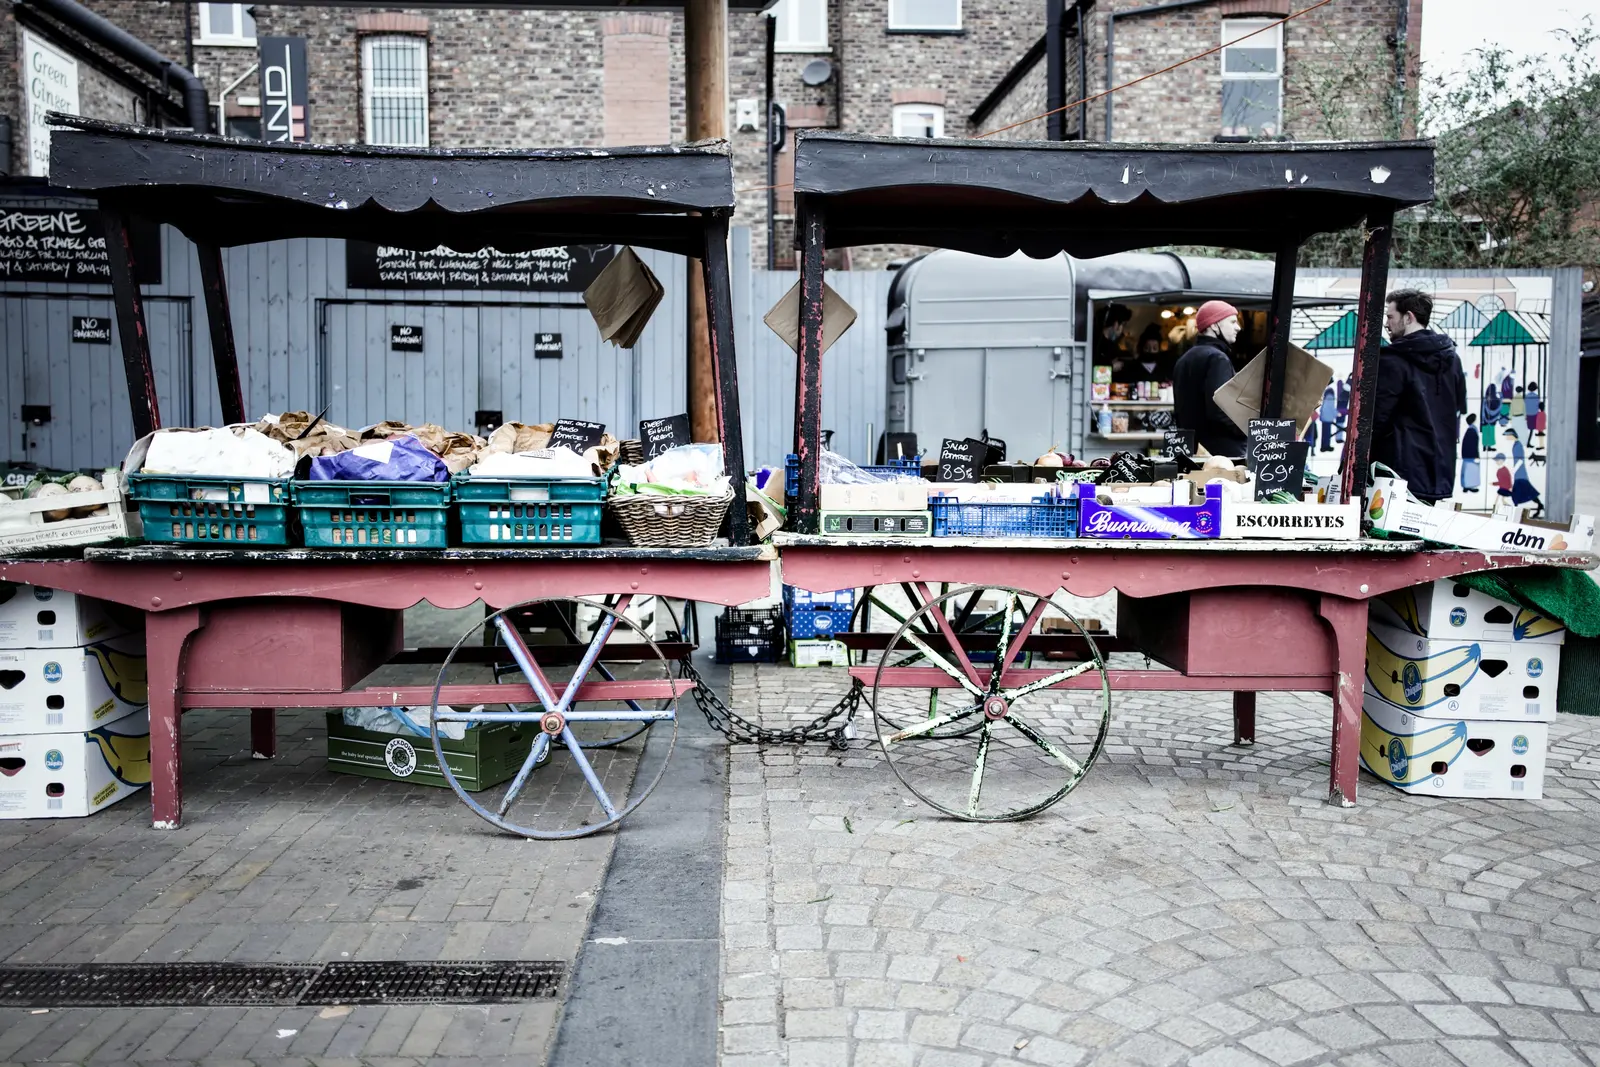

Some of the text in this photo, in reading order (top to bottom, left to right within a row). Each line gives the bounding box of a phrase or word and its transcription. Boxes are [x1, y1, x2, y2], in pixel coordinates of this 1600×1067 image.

[33, 52, 68, 88] Green
[32, 77, 71, 113] Ginger
[265, 66, 288, 141] ND
[40, 236, 86, 250] TRAVEL
[380, 270, 408, 284] EVERY
[481, 271, 489, 283] &
[81, 318, 98, 329] NO
[400, 326, 412, 336] NO
[541, 334, 553, 343] NO
[641, 419, 666, 430] SWEET
[553, 431, 589, 442] POTATOES
[1255, 433, 1279, 441] ONIONS
[943, 440, 969, 451] SALAD
[1261, 442, 1290, 451] SPRING
[941, 450, 974, 462] POTATOES
[1257, 452, 1288, 461] ONIONS
[1236, 515, 1345, 528] ESCORREYES
[1502, 528, 1545, 550] abm
[387, 740, 414, 758] BLACKDOWN
[388, 761, 414, 775] GROWERS
